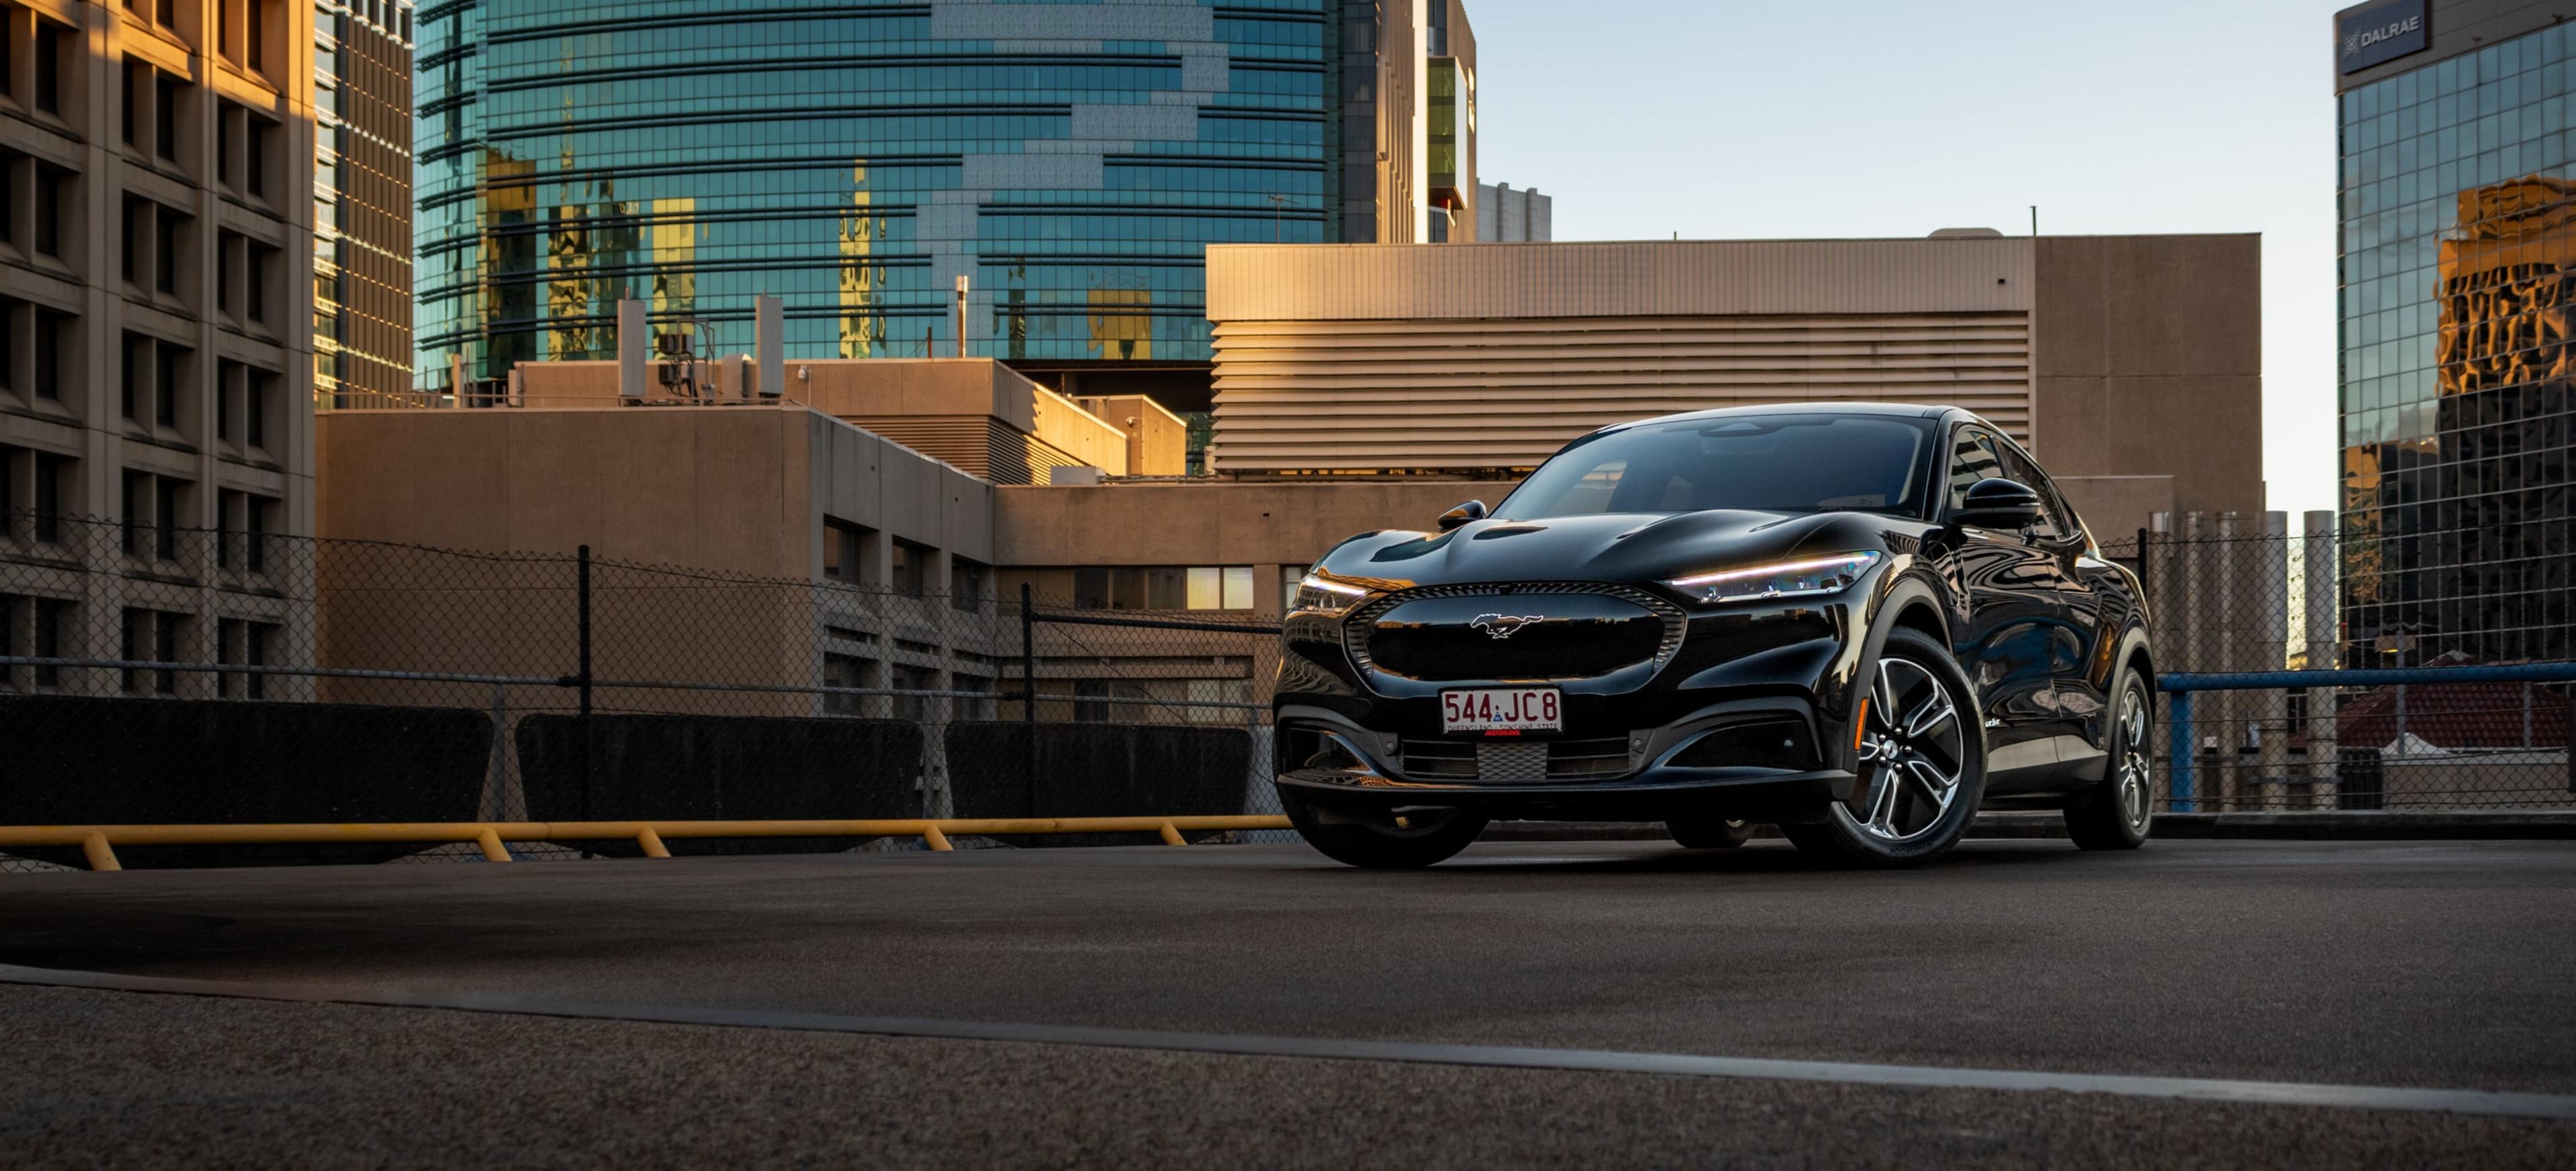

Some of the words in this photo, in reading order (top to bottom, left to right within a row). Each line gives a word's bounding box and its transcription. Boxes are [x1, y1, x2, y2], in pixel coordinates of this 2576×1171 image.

[2361, 16, 2420, 46] DALRAE
[1445, 693, 1492, 722] 544
[1504, 692, 1558, 722] JC8
